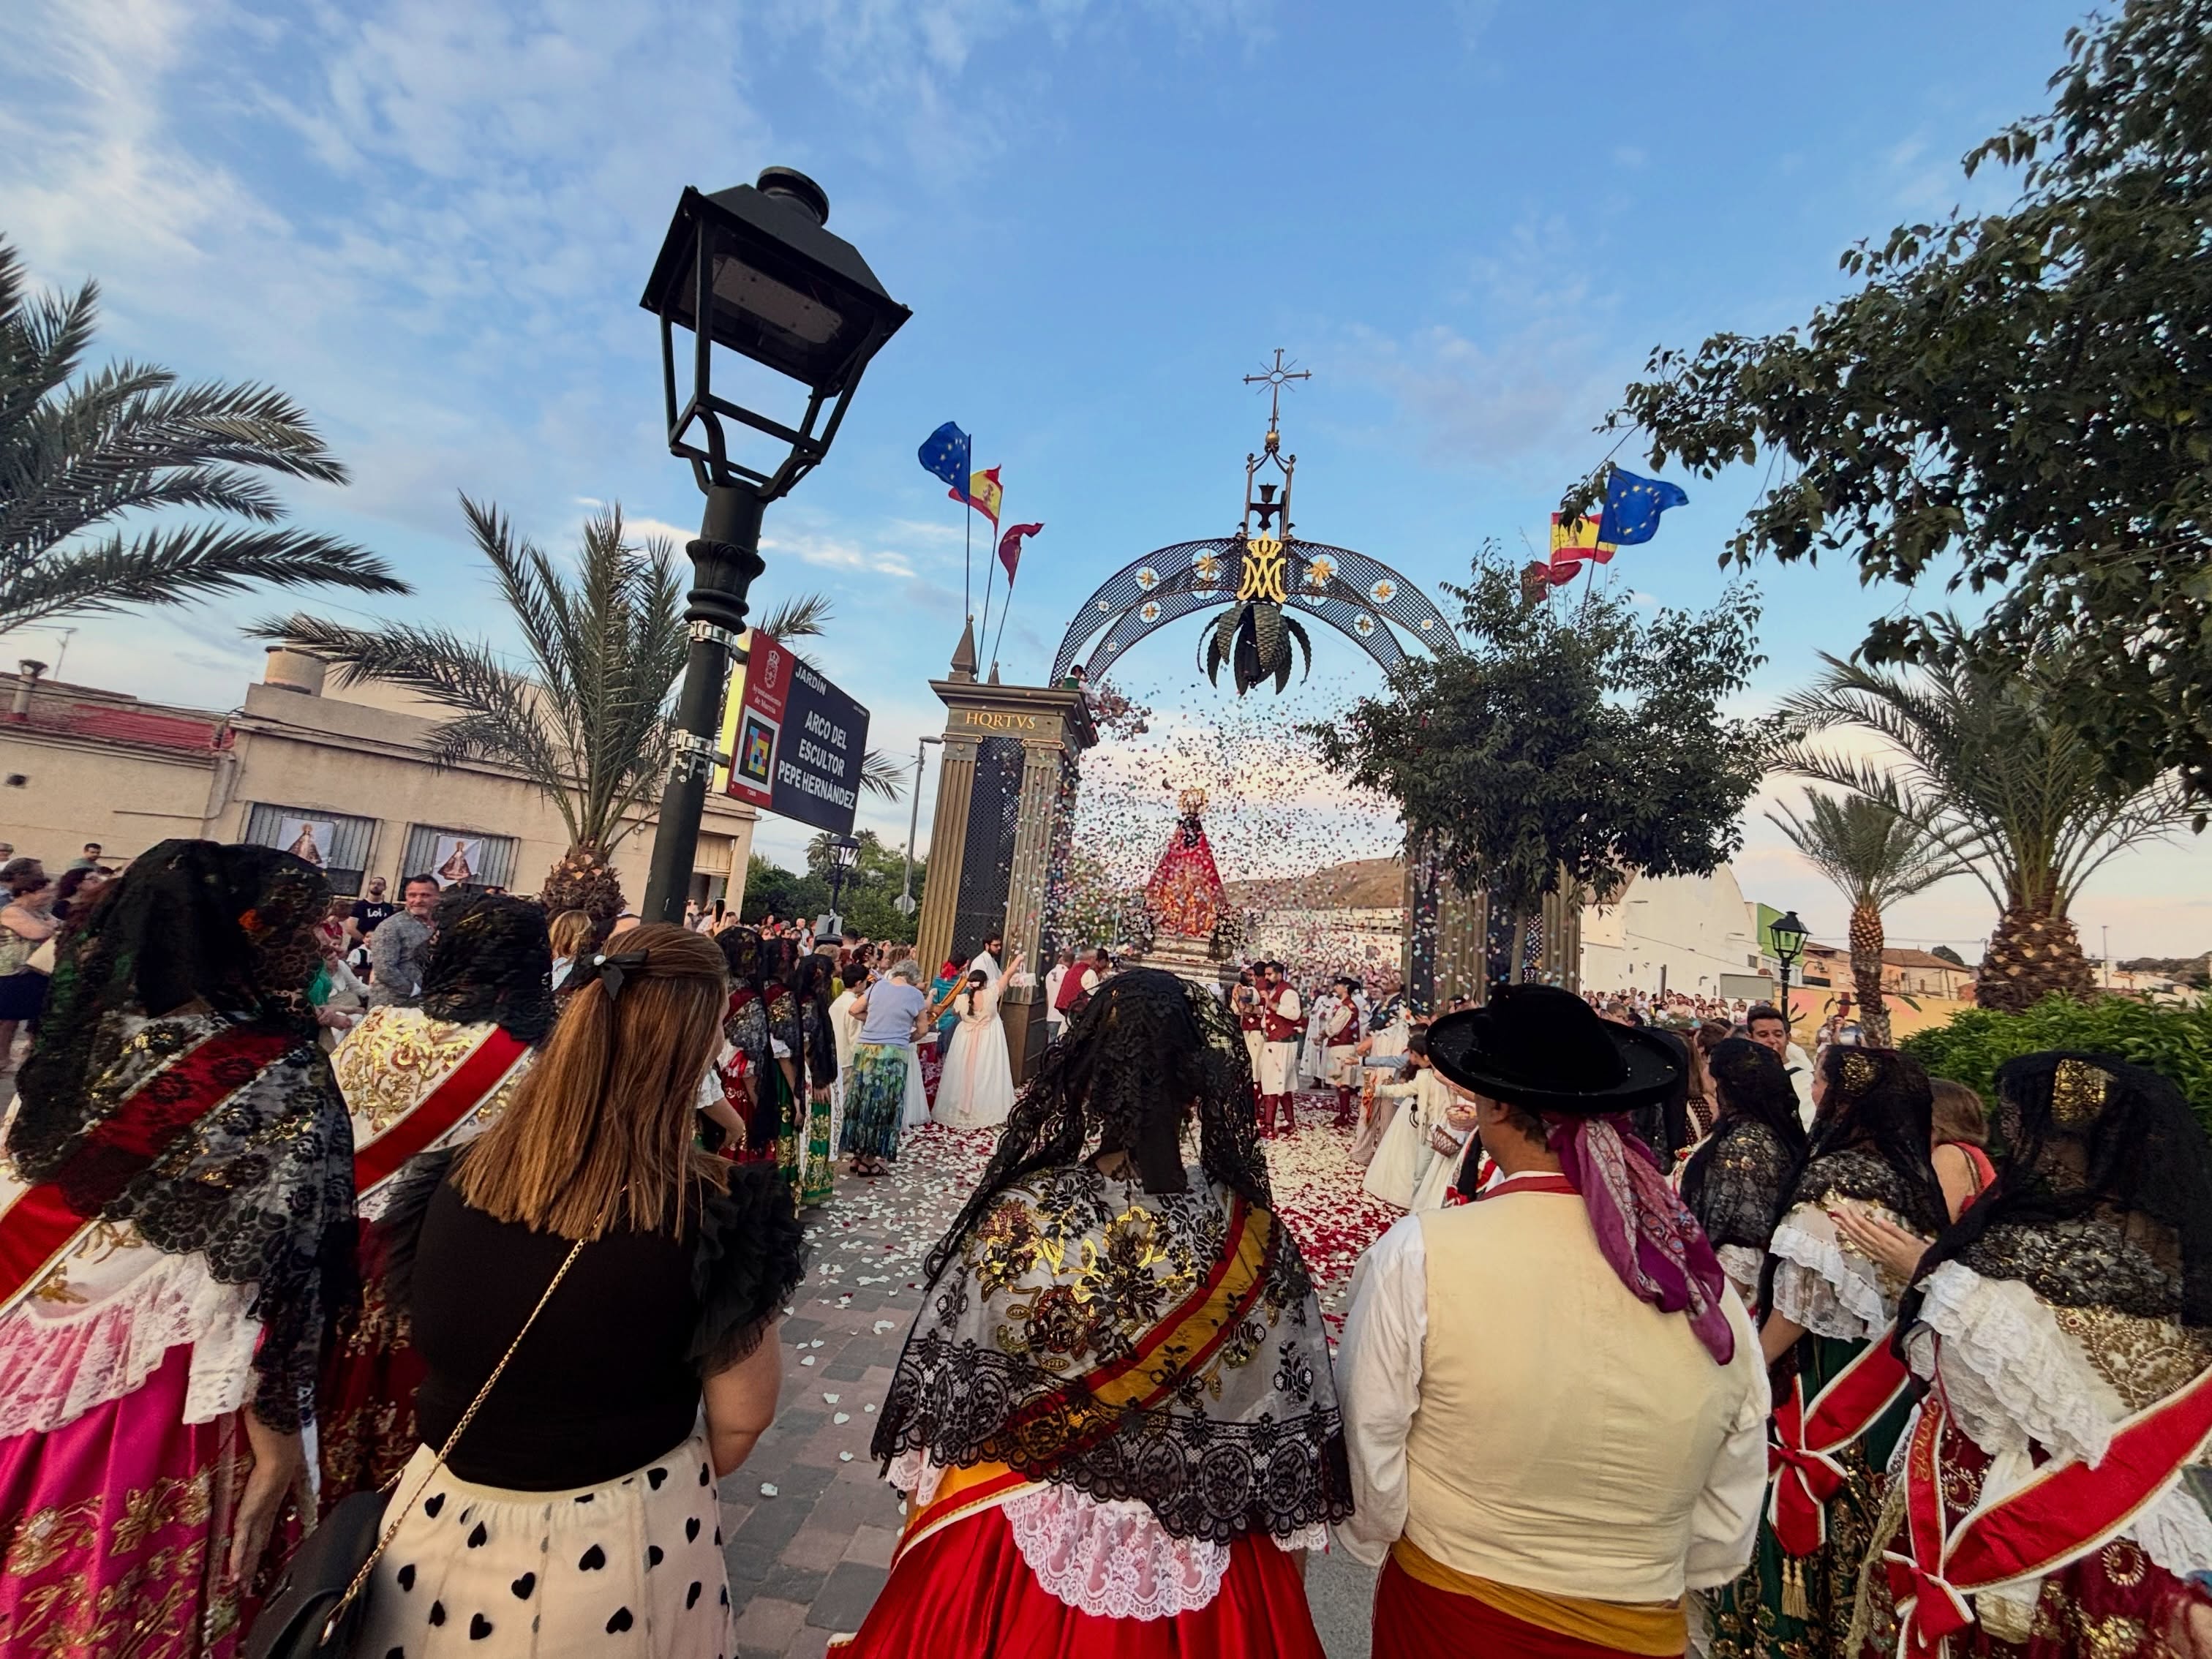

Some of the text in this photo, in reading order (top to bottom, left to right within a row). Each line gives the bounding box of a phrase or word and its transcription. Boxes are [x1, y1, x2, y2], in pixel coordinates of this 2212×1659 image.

[795, 666, 827, 696] JARDÍN
[805, 710, 831, 740] ARCO
[831, 725, 847, 750] DEL
[798, 737, 845, 778] ESCULTOR
[778, 759, 856, 810] PEPE HERNÁNDEZ
